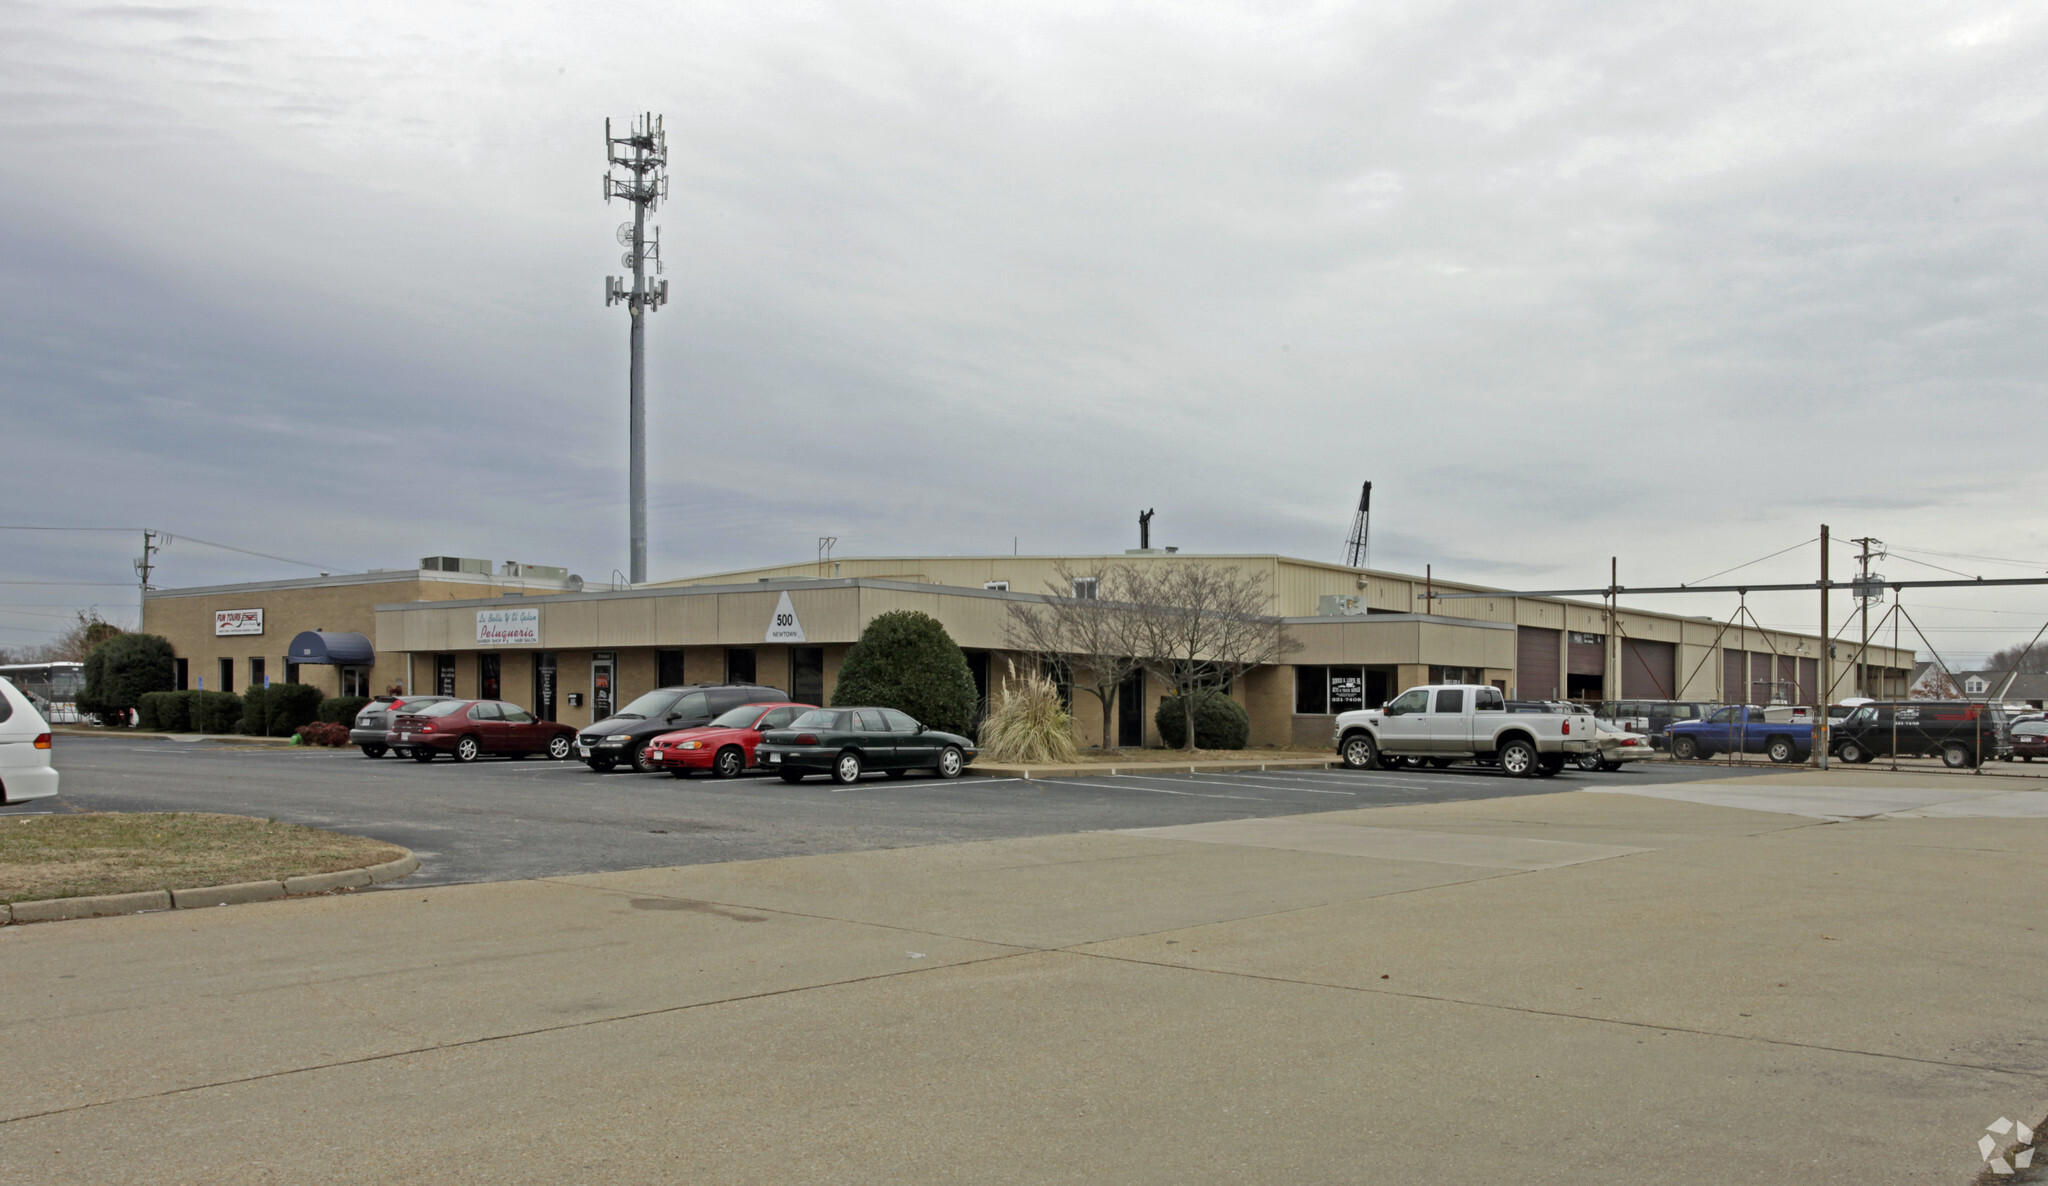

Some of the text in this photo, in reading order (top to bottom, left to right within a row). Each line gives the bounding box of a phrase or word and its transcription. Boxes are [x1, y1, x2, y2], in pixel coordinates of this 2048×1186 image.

[1489, 603, 1494, 612] 5
[217, 612, 241, 622] FUN TOURS
[488, 613, 503, 622] Bella
[777, 613, 793, 627] 500
